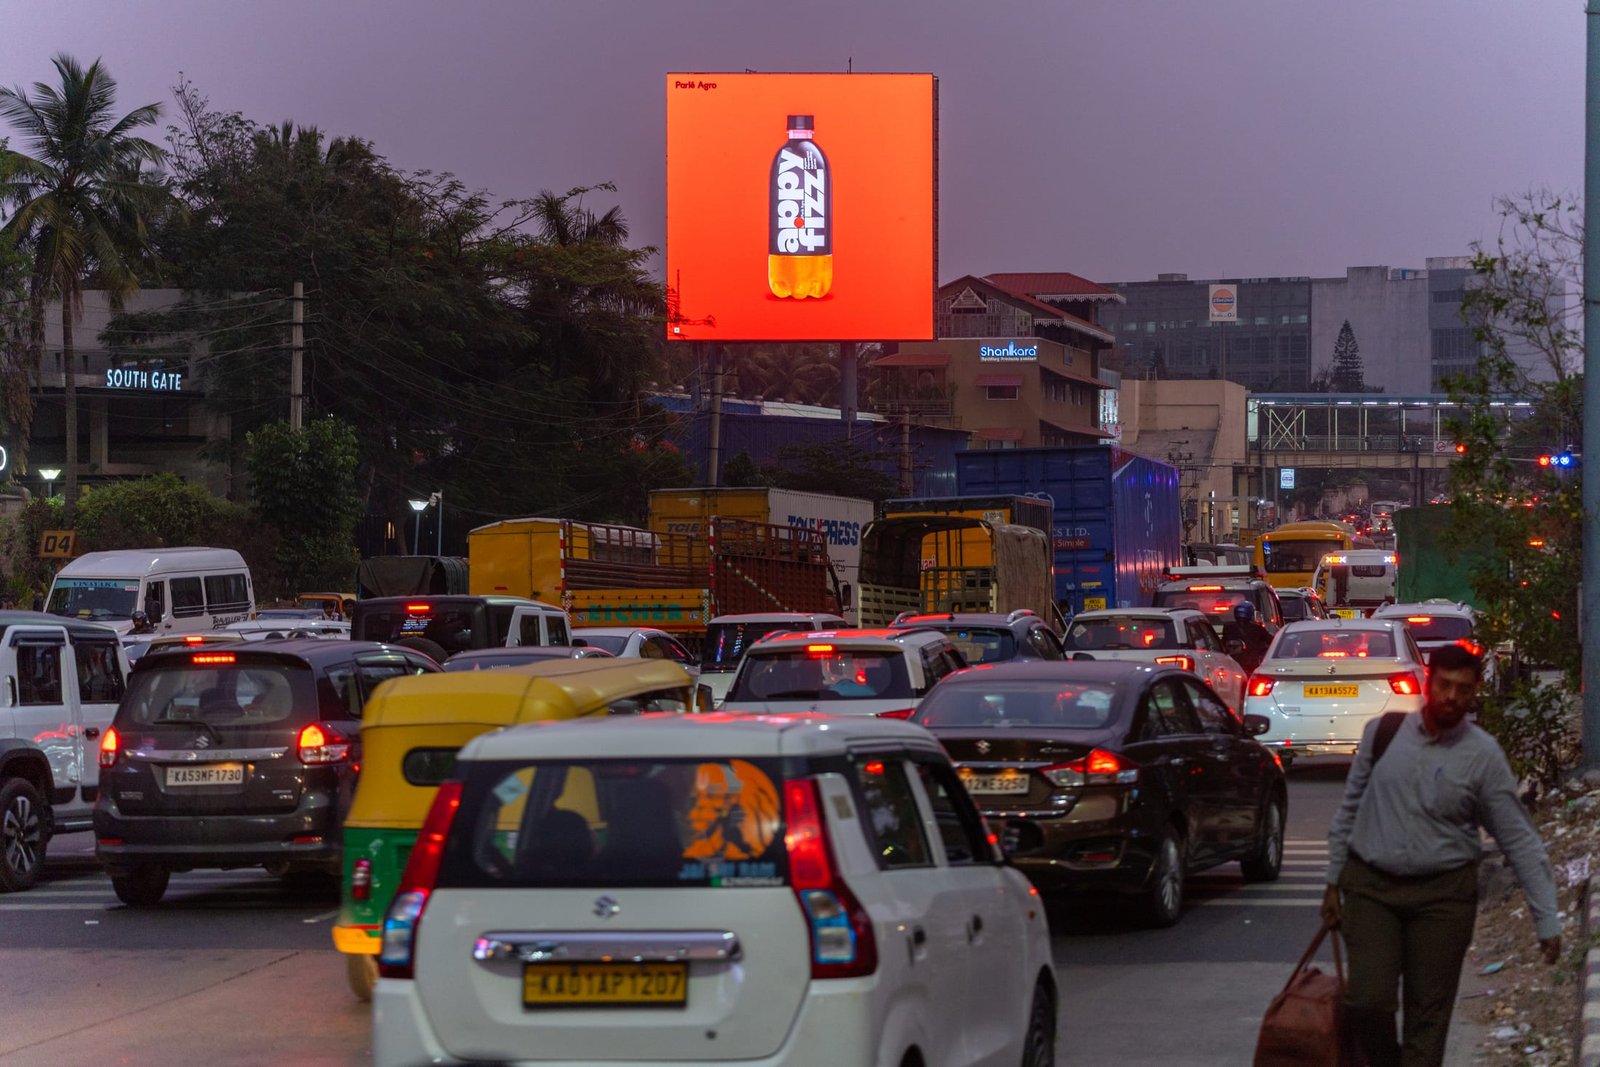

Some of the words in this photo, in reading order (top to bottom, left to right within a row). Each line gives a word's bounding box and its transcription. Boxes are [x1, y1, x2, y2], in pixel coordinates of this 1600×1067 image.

[698, 81, 717, 91] Agro
[777, 149, 804, 253] appy
[798, 168, 825, 252] fizz
[980, 341, 1036, 357] Shankara
[106, 368, 148, 388] SOUTH
[151, 371, 182, 391] GATE
[44, 535, 71, 553] 04
[588, 603, 683, 621] EICHER
[174, 769, 241, 783] KA53MF1730
